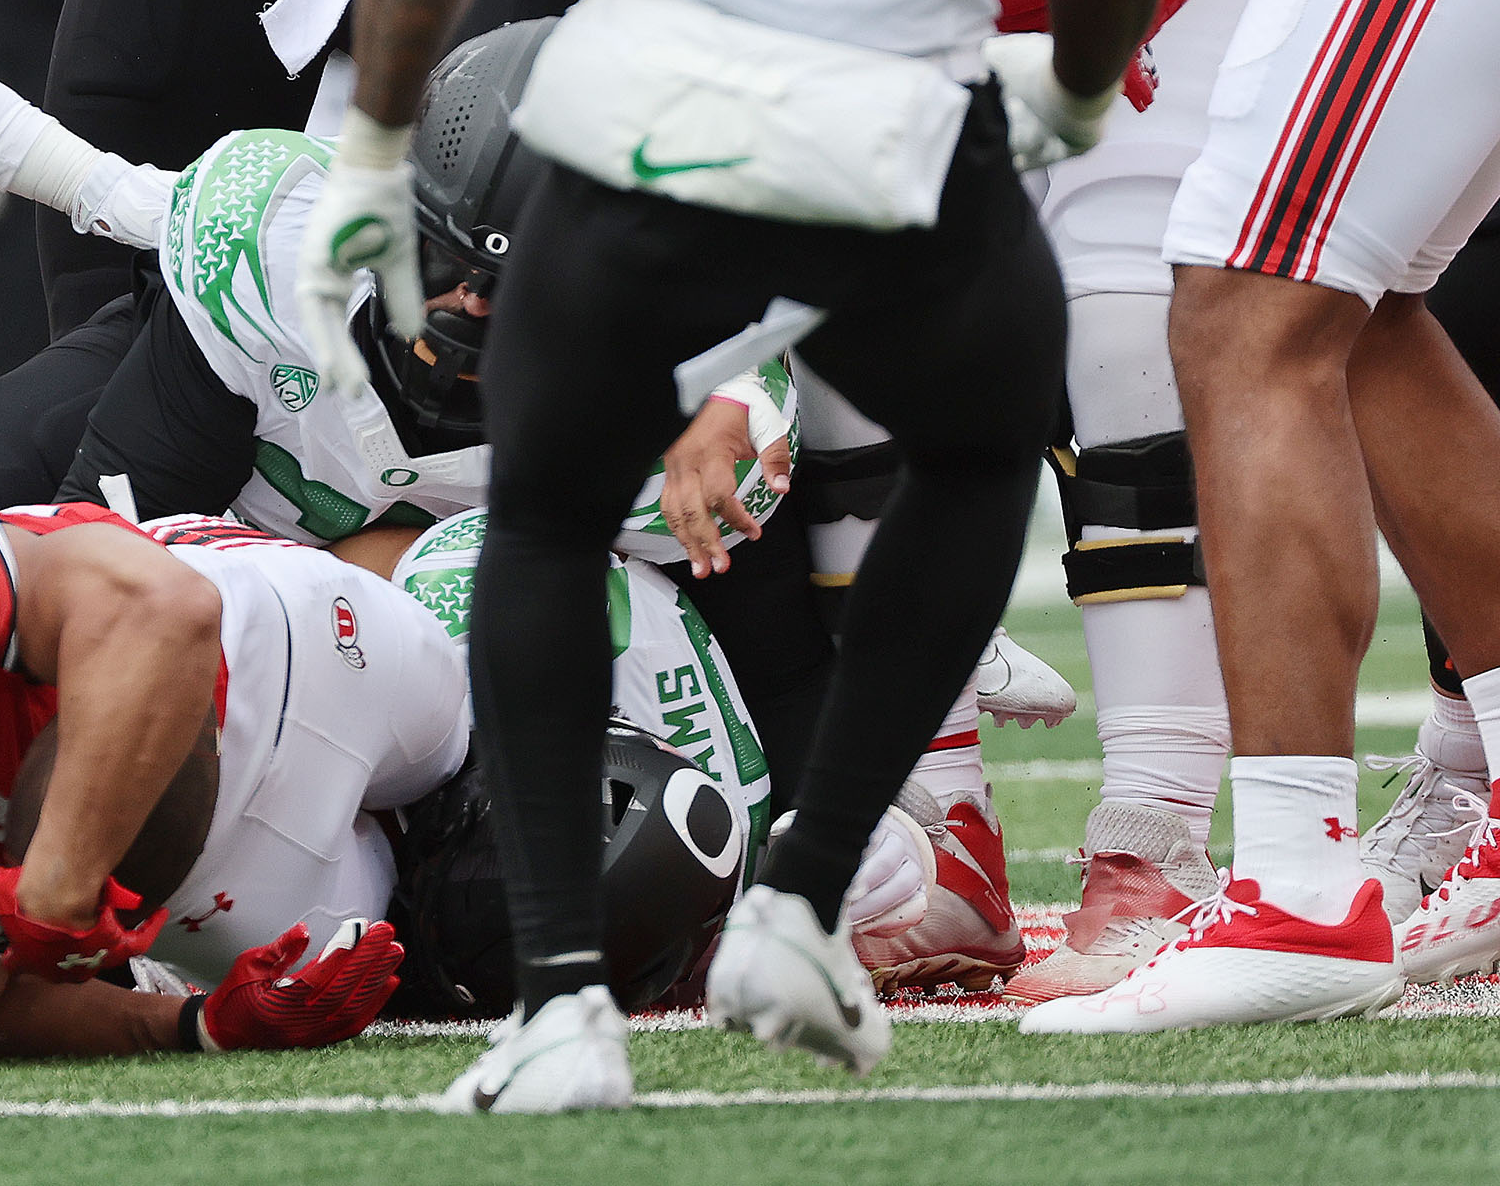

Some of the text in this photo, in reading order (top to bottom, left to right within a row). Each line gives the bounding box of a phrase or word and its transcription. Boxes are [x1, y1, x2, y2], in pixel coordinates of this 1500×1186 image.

[485, 233, 509, 254] O
[274, 368, 317, 404] PAC
[278, 387, 301, 409] 12
[663, 767, 743, 879] O
